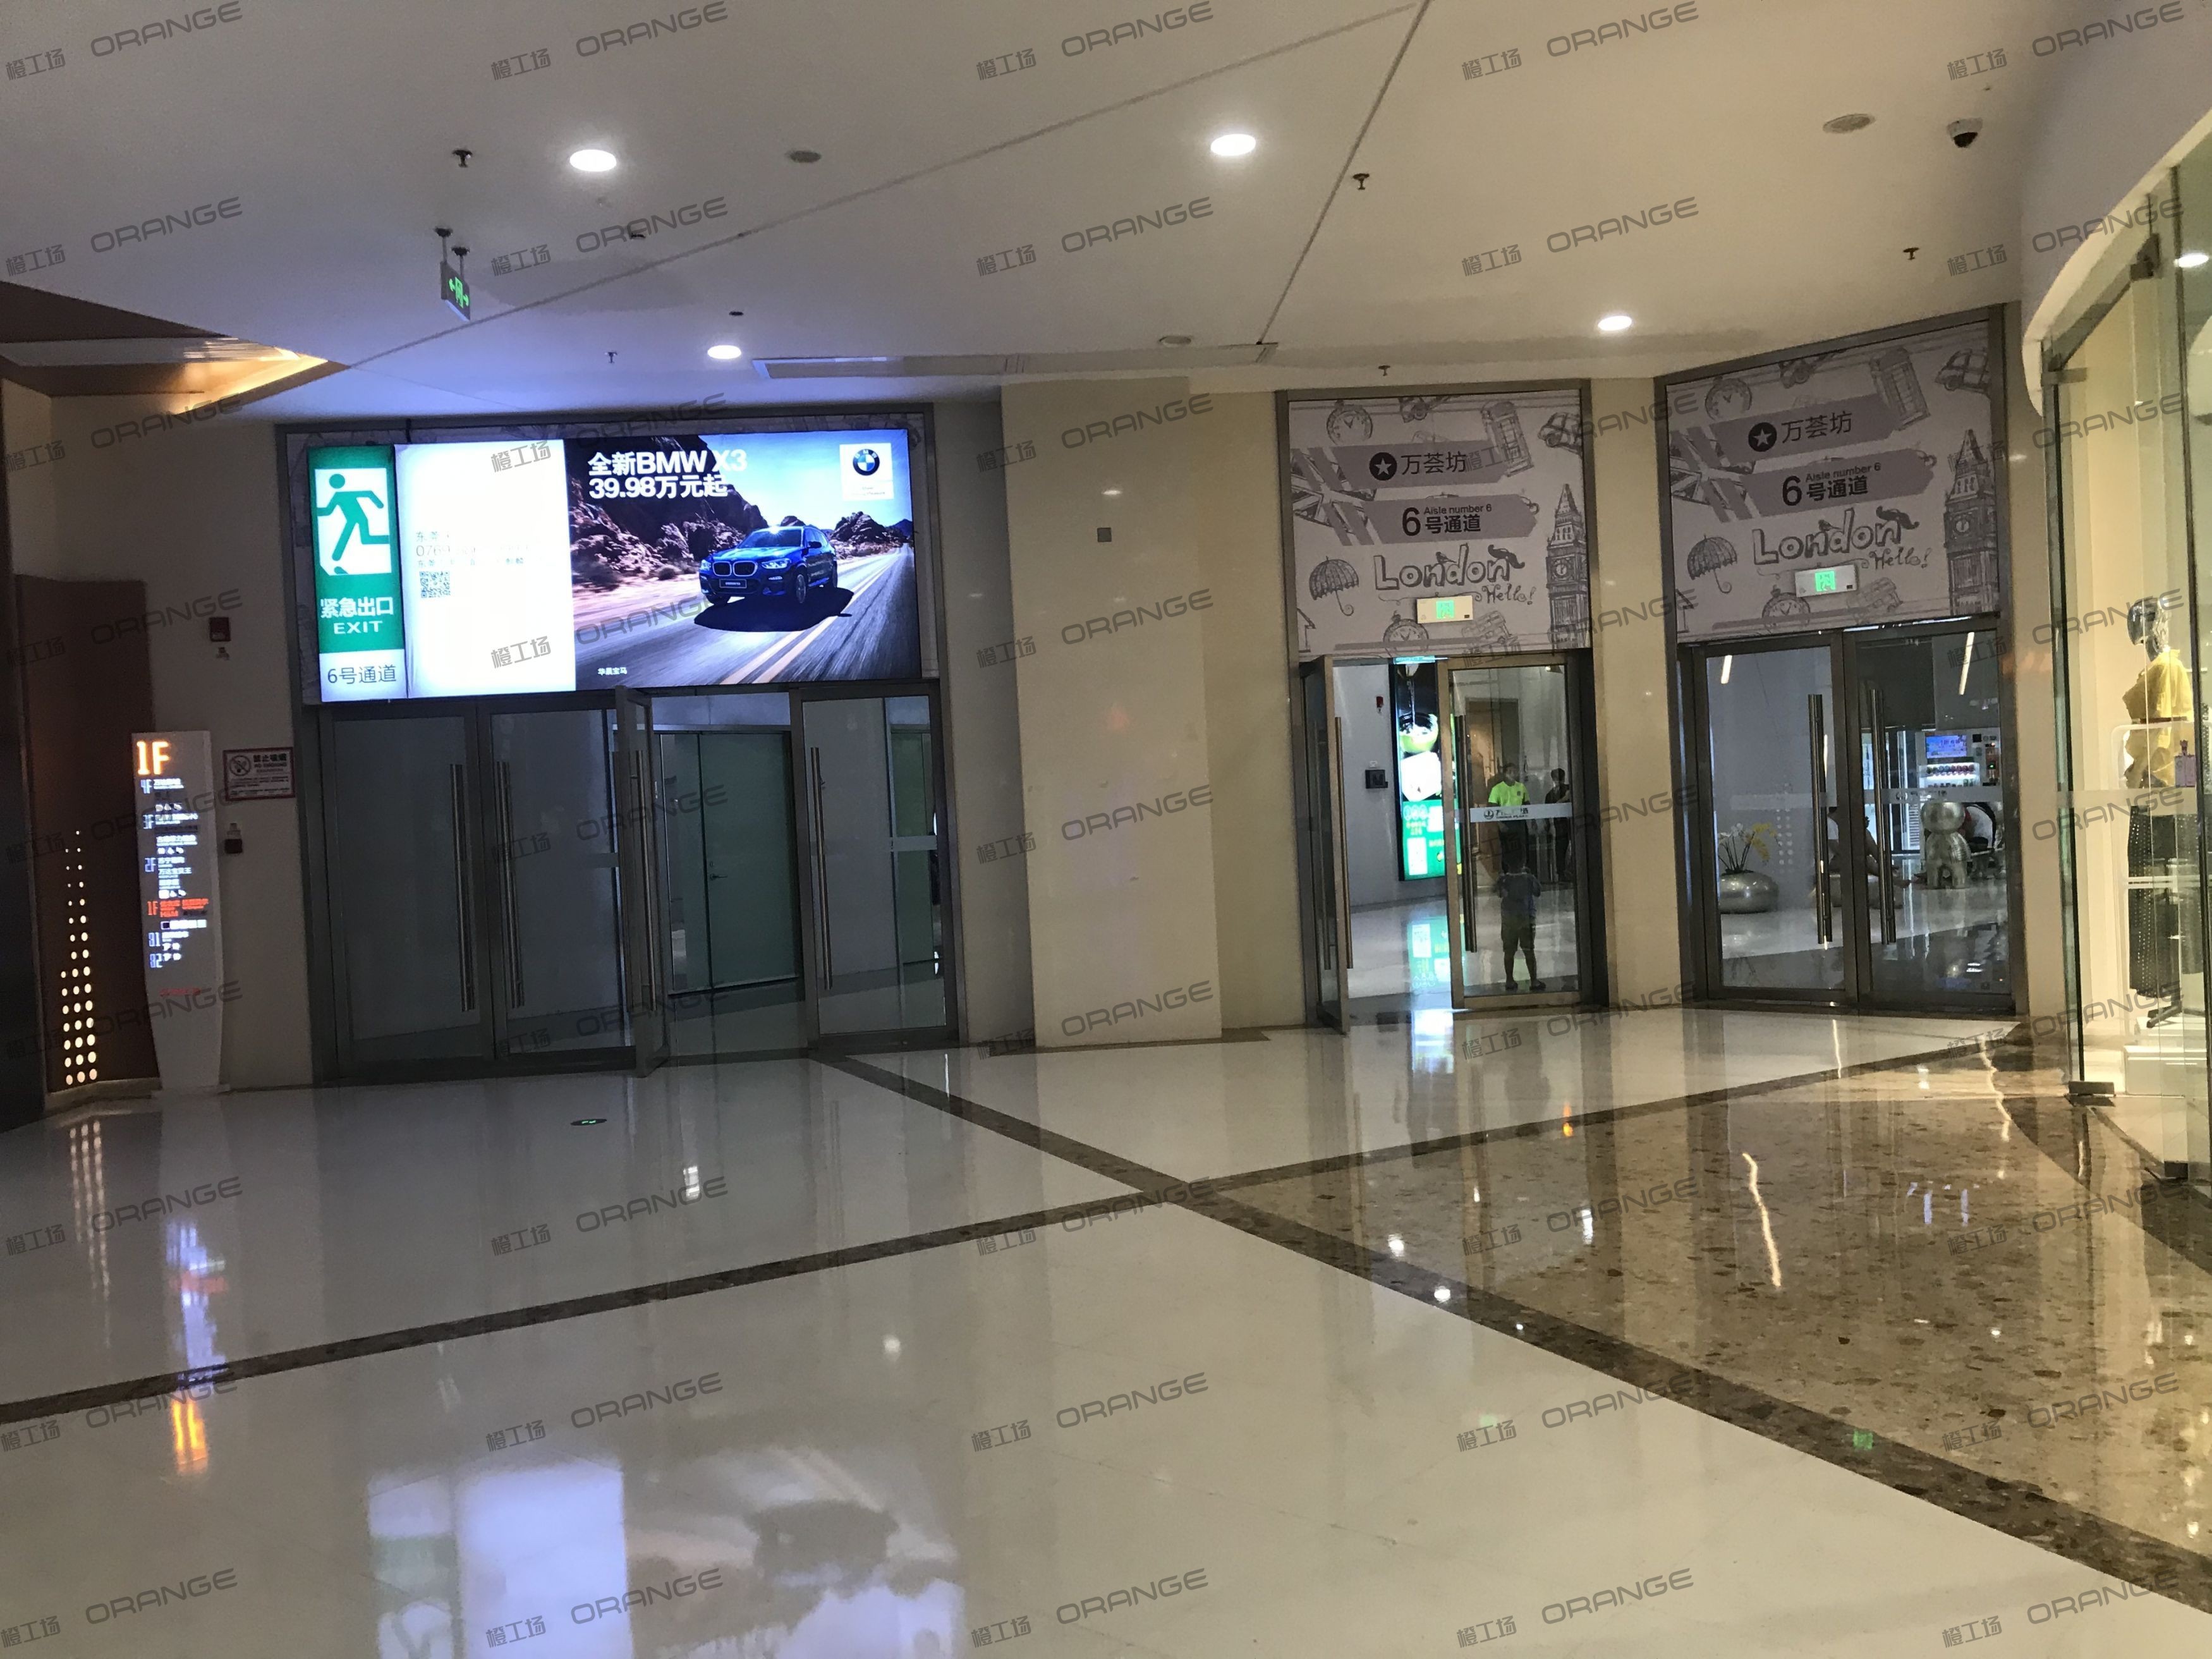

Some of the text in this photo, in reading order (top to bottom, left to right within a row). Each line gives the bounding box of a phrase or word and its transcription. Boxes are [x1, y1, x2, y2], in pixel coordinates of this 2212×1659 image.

[1782, 411, 1852, 444] 万荟坊
[587, 449, 748, 477] 全新BMW X3
[1401, 451, 1467, 476] 万荟坊
[1806, 462, 1881, 482] Aisle number 6
[588, 473, 728, 500] 39.98万元起
[1782, 475, 1868, 506] 6号通道
[1401, 506, 1481, 537] 6号通道
[1423, 504, 1492, 516] Aisle number 6
[1752, 507, 1902, 566] London
[1373, 543, 1511, 591] London
[1869, 547, 1932, 570] Hello!
[1483, 584, 1536, 605] Hello!
[320, 597, 394, 619] 紧急出口
[333, 621, 383, 635] EXIT
[327, 664, 398, 685] 6号通道
[136, 740, 171, 775] 1F
[144, 857, 157, 872] 2F
[147, 901, 158, 916] 1F
